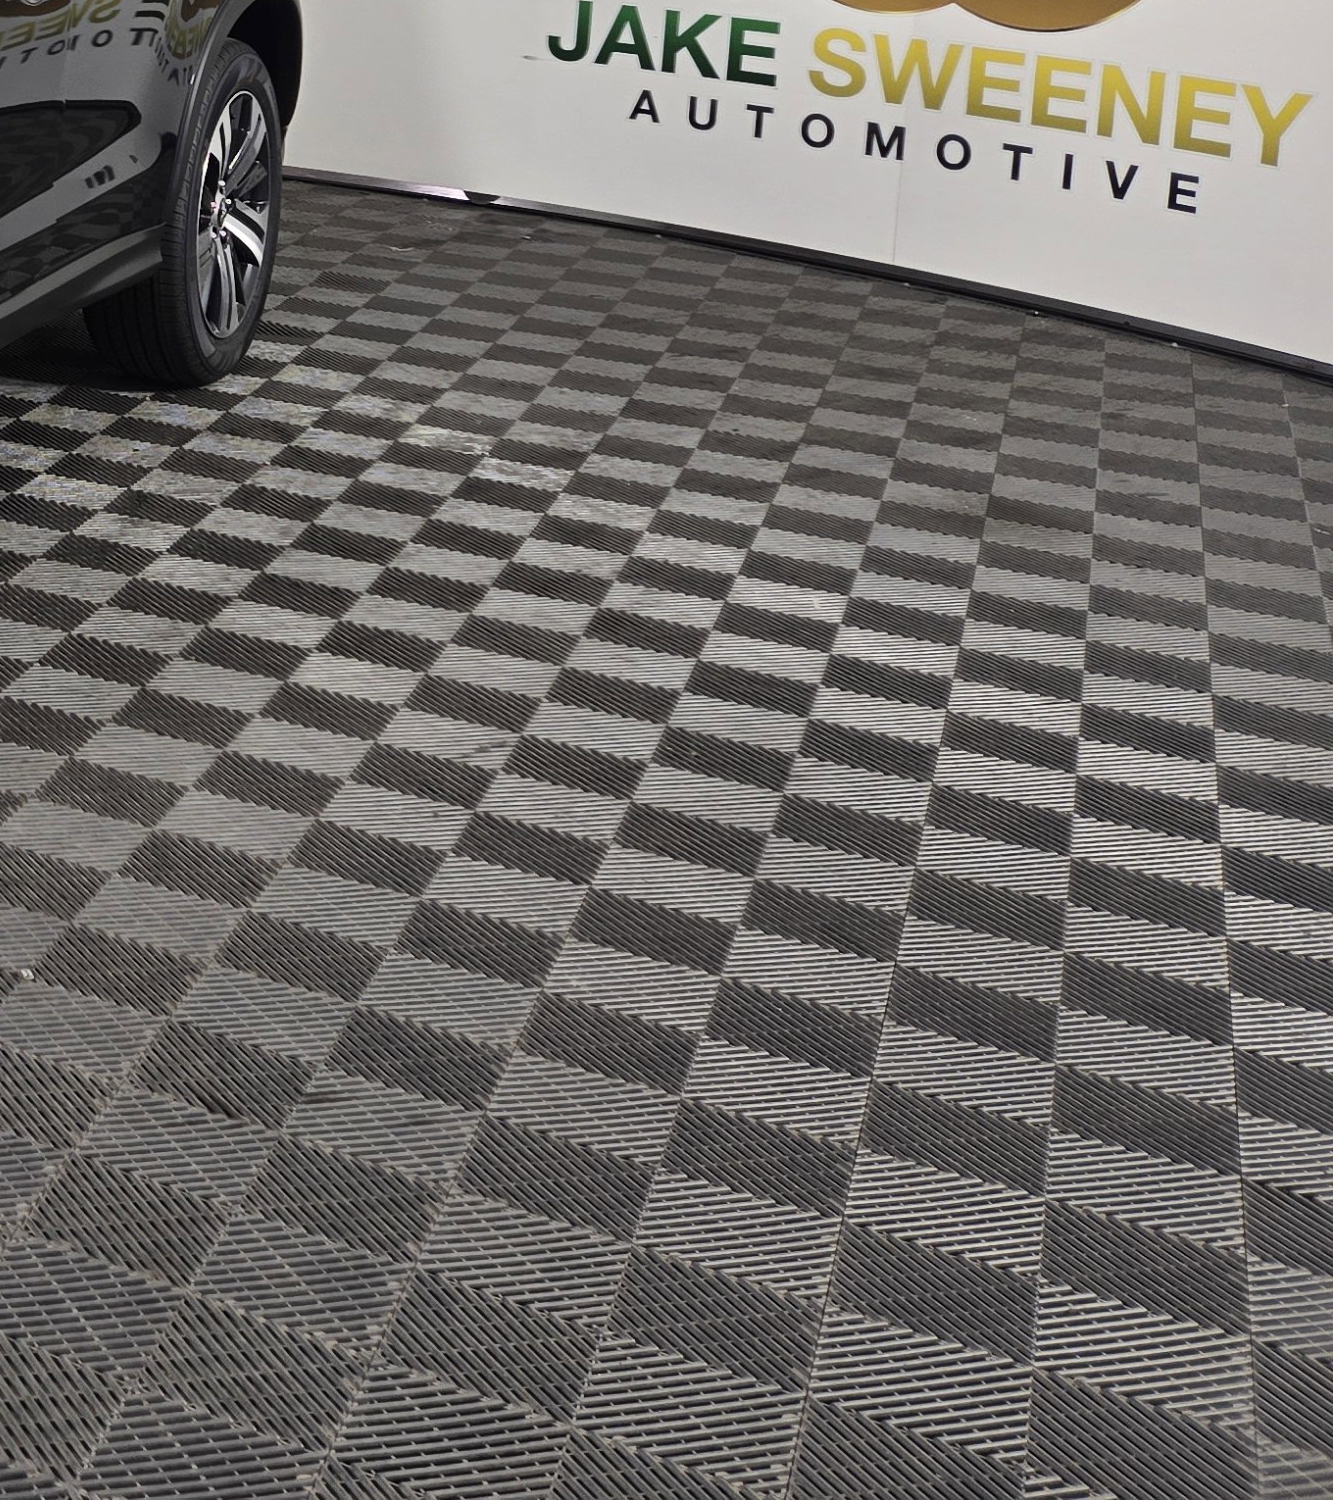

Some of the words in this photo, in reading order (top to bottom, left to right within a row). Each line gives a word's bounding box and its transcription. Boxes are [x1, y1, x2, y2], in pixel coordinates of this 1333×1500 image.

[548, 0, 781, 87] JAKE
[809, 26, 1314, 168] SWEENEY
[629, 89, 1200, 214] AUTOMOTIVE
